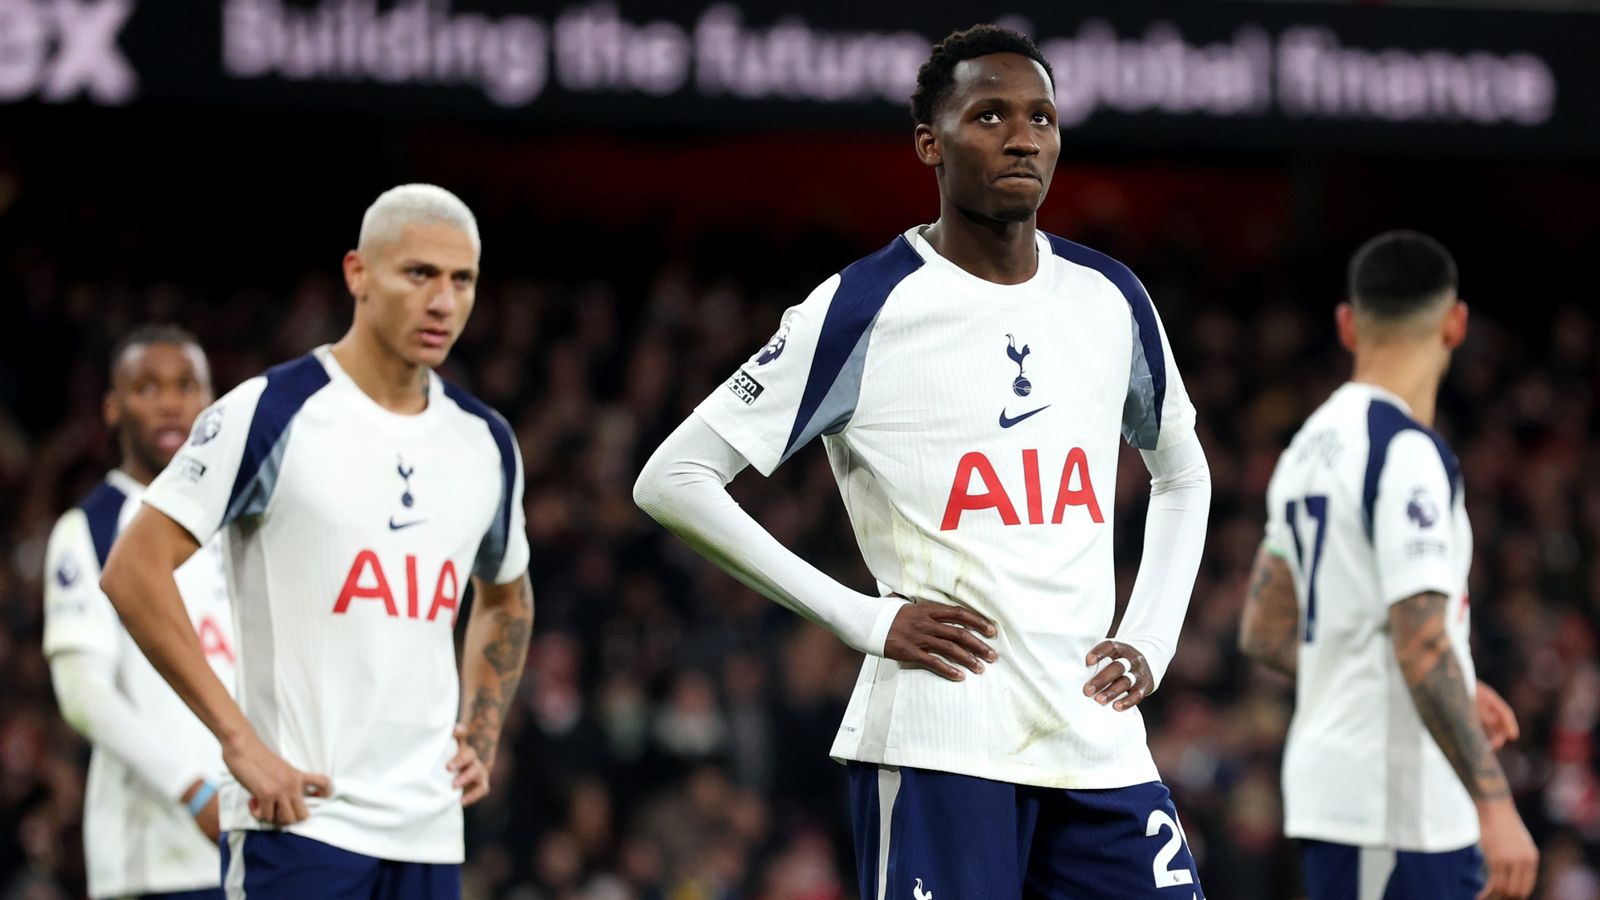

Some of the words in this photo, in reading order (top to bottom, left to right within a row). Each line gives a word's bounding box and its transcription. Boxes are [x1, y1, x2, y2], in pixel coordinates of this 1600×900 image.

[222, 0, 547, 107] Building
[555, 0, 690, 95] the
[695, 3, 935, 105] future
[1042, 17, 1271, 128] global
[1278, 24, 1555, 126] finance
[940, 446, 1105, 531] AIA
[332, 548, 459, 629] AIA
[1285, 495, 1328, 643] 17
[1145, 809, 1193, 889] 2
